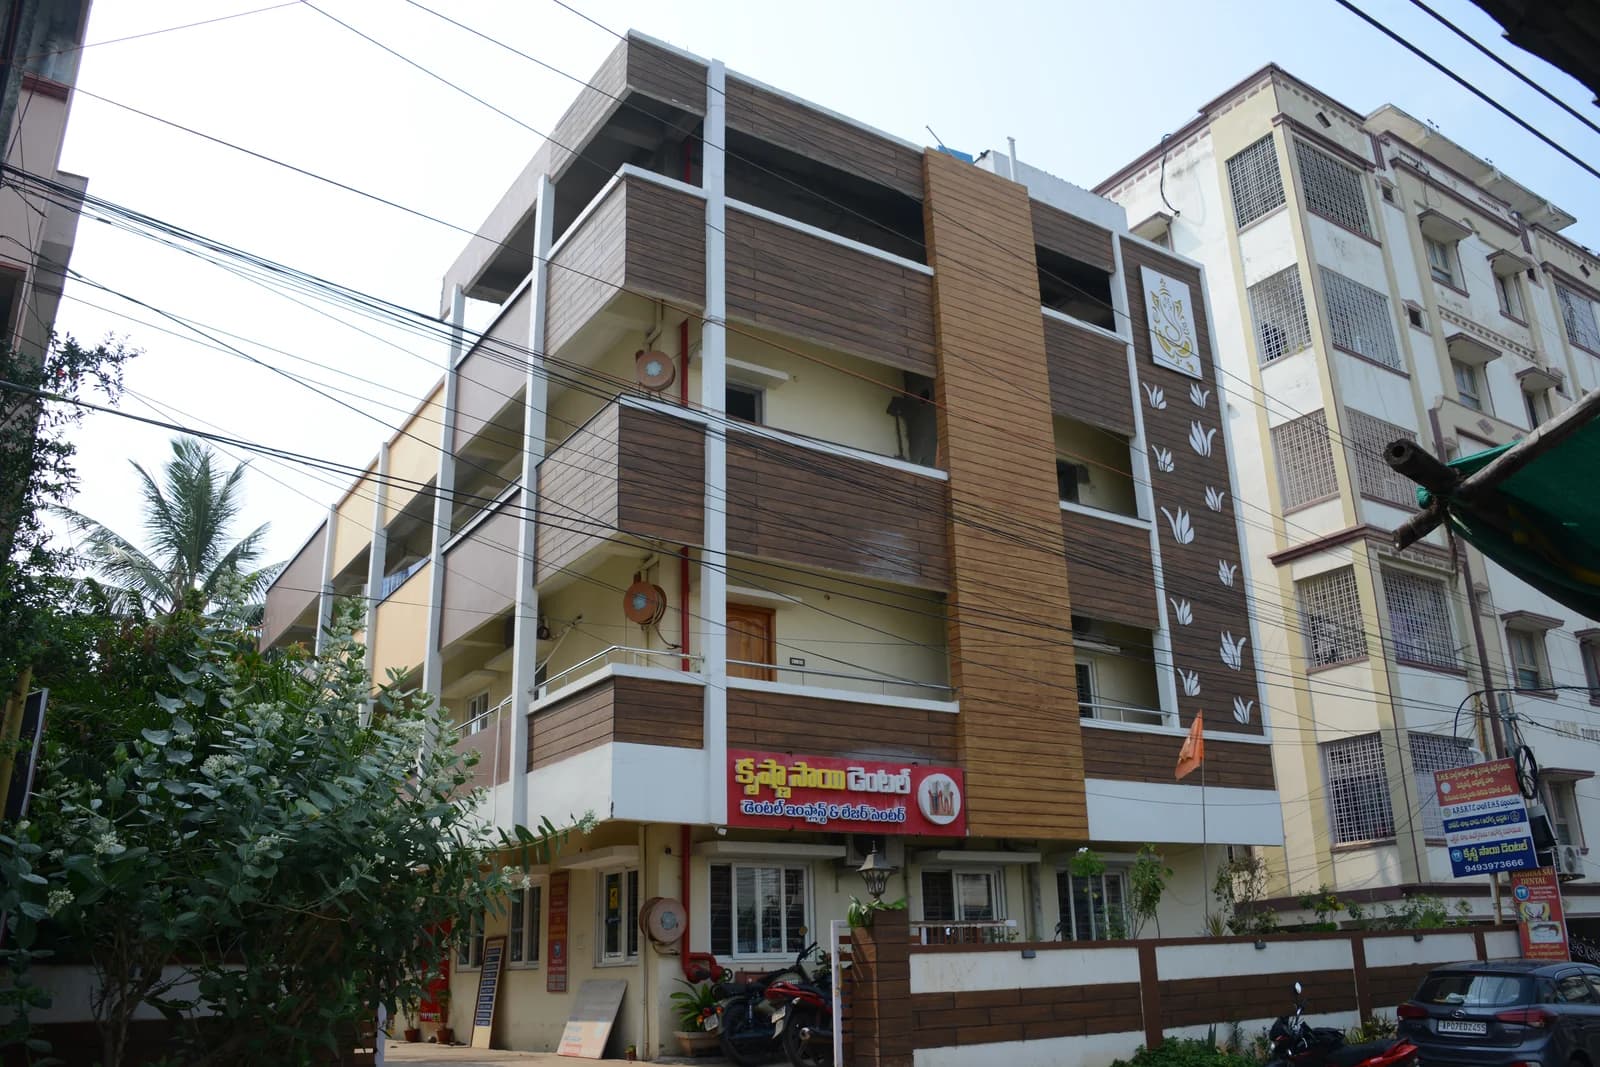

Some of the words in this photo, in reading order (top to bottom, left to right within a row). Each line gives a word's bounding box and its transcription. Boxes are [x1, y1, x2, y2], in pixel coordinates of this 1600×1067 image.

[789, 761, 846, 790] సాయి
[847, 767, 911, 794] డెంటల్
[741, 800, 785, 816] డెంటల్
[829, 805, 839, 818] &
[841, 804, 871, 821] లేజర్
[871, 807, 906, 823] సెంటర్
[1465, 858, 1524, 873] 9493973666
